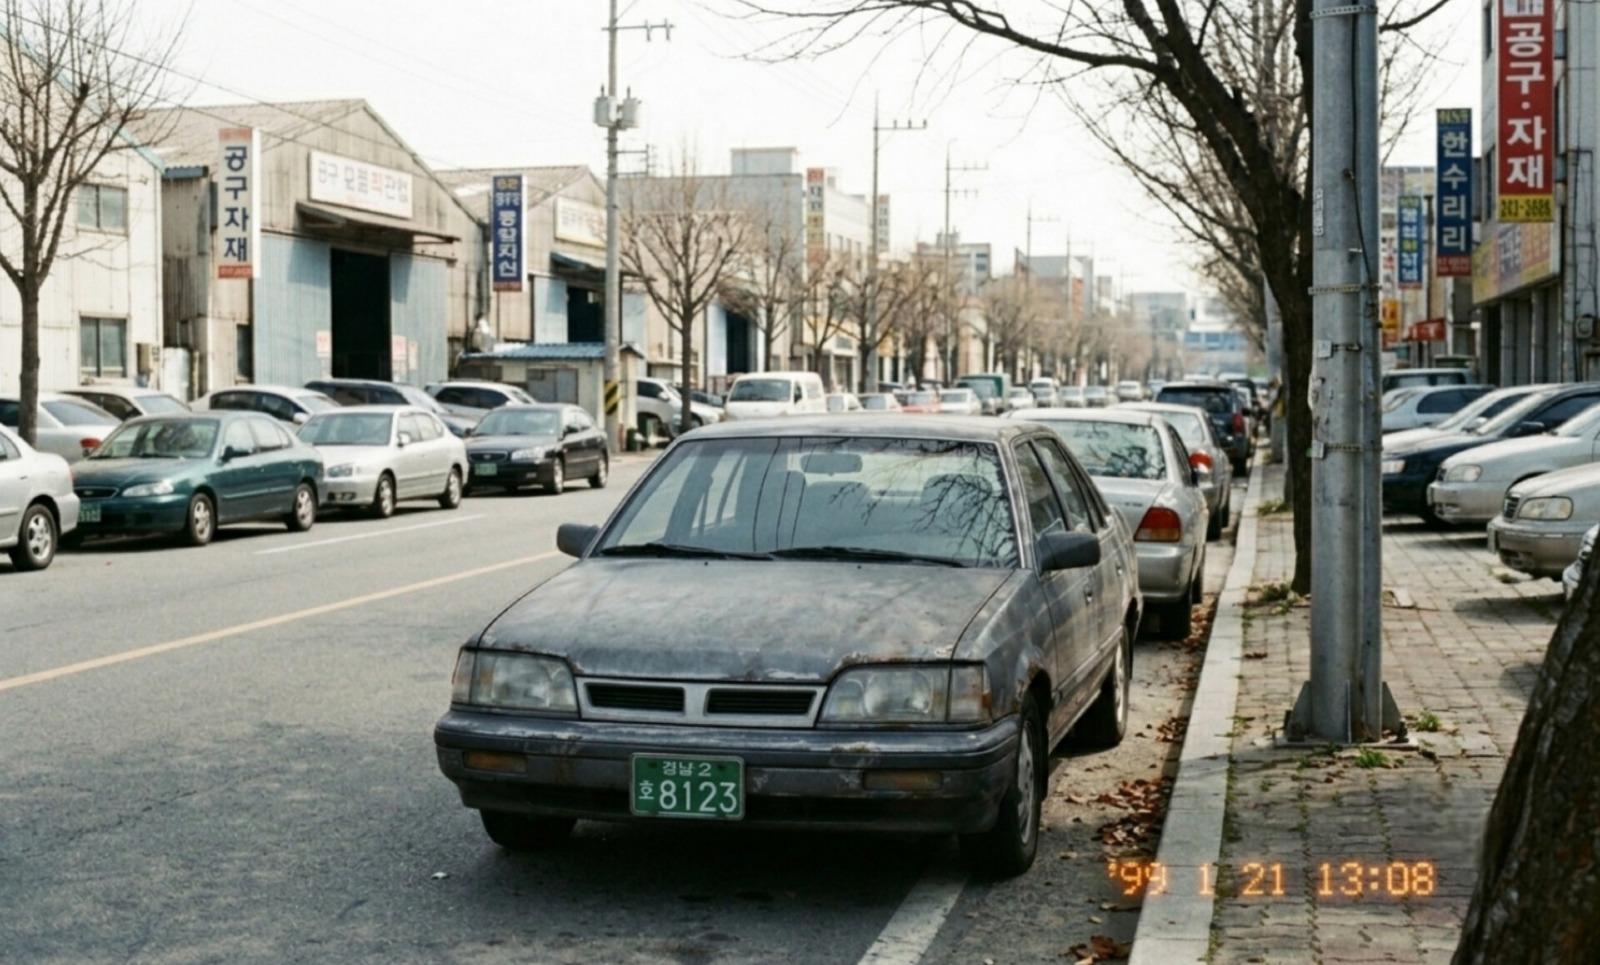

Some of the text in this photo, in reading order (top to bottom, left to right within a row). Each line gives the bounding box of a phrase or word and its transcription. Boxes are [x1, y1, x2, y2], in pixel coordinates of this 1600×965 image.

[223, 146, 250, 262] 공구자재
[698, 762, 712, 777] 2
[638, 780, 737, 813] 호 8123
